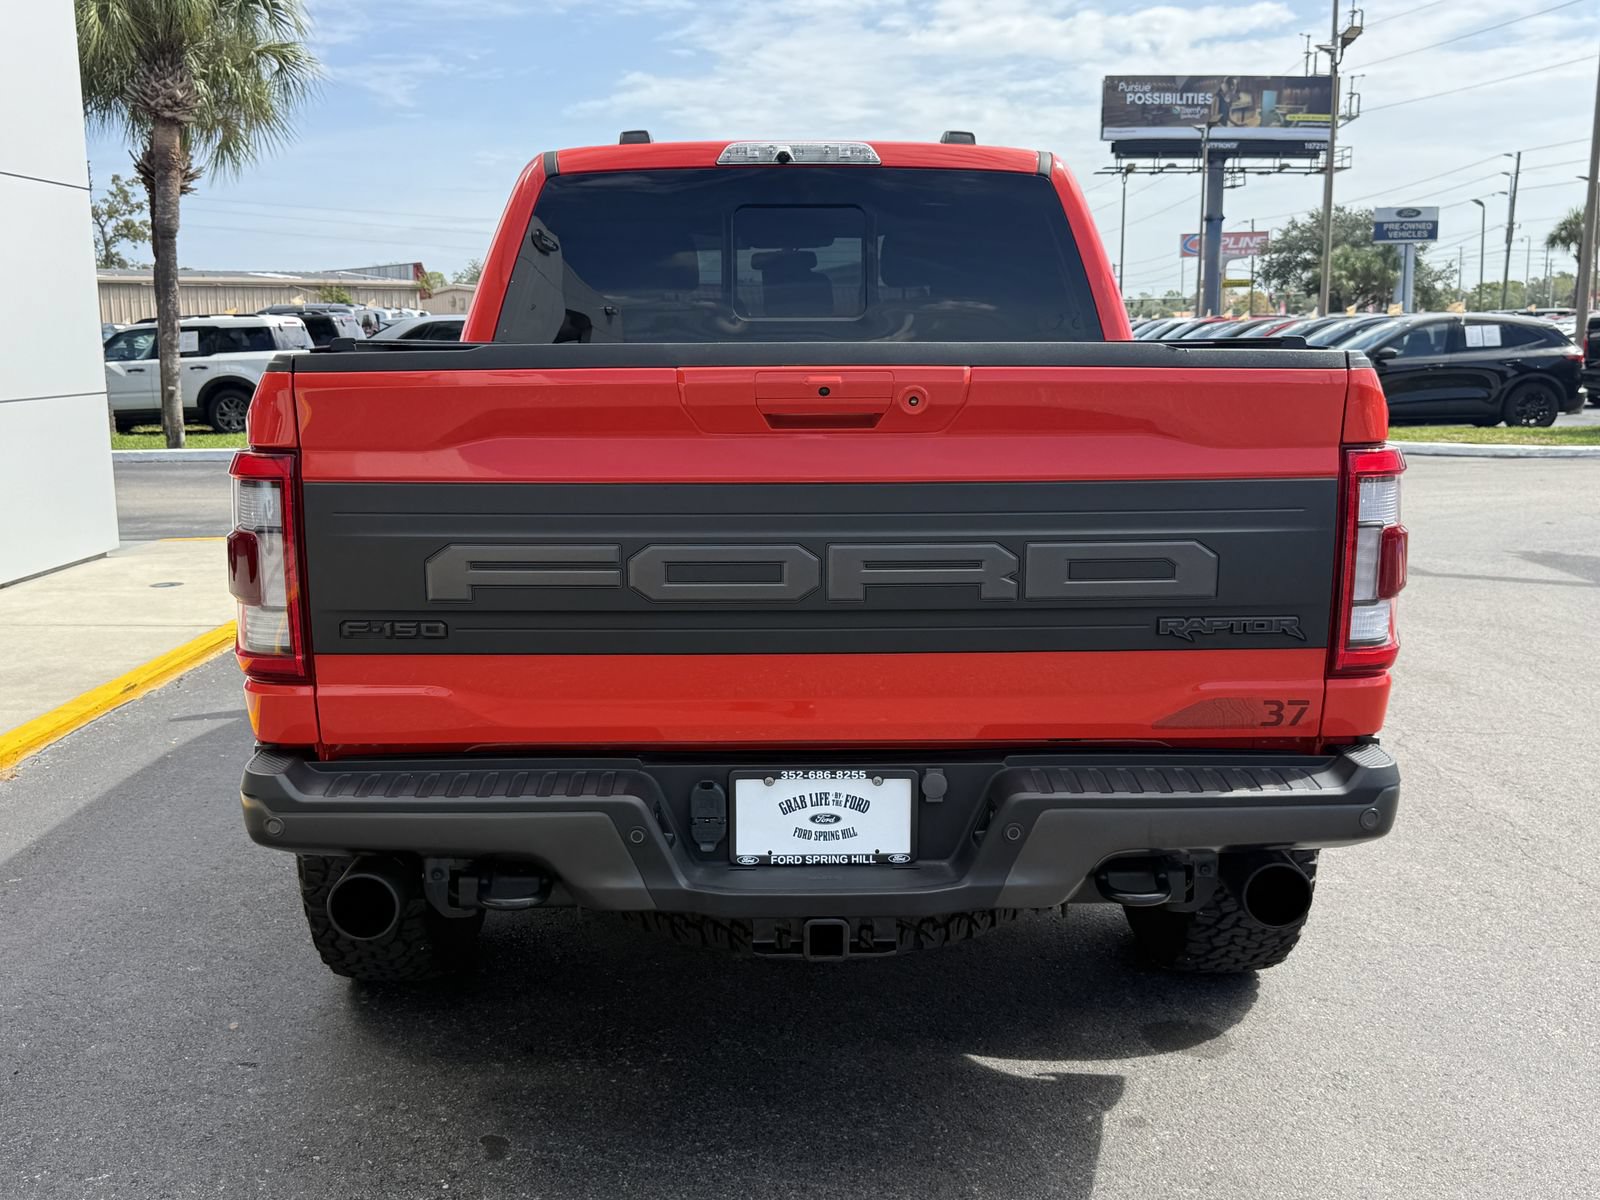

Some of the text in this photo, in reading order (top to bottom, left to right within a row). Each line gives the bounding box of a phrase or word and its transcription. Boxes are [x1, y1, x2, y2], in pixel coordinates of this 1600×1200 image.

[1118, 82, 1151, 92] Pursue
[1126, 93, 1213, 105] POSSIBILITIES
[1383, 223, 1433, 231] PRE-OWNED
[1388, 231, 1428, 240] VEHICLES
[425, 540, 1219, 603] FORD
[340, 620, 448, 639] F-150
[1157, 616, 1306, 641] RAPTOR
[1260, 700, 1310, 726] 37
[780, 770, 867, 780] 352-686-8255
[778, 795, 807, 815] GRAB
[809, 792, 830, 807] LIFE
[832, 799, 843, 807] THE
[843, 794, 871, 814] FORD
[815, 814, 836, 824] Ford
[793, 826, 858, 842] FORD SPRING HILL
[740, 855, 756, 863] Ford
[771, 855, 877, 864] FORD SPRING HILL
[891, 854, 907, 862] Ford
